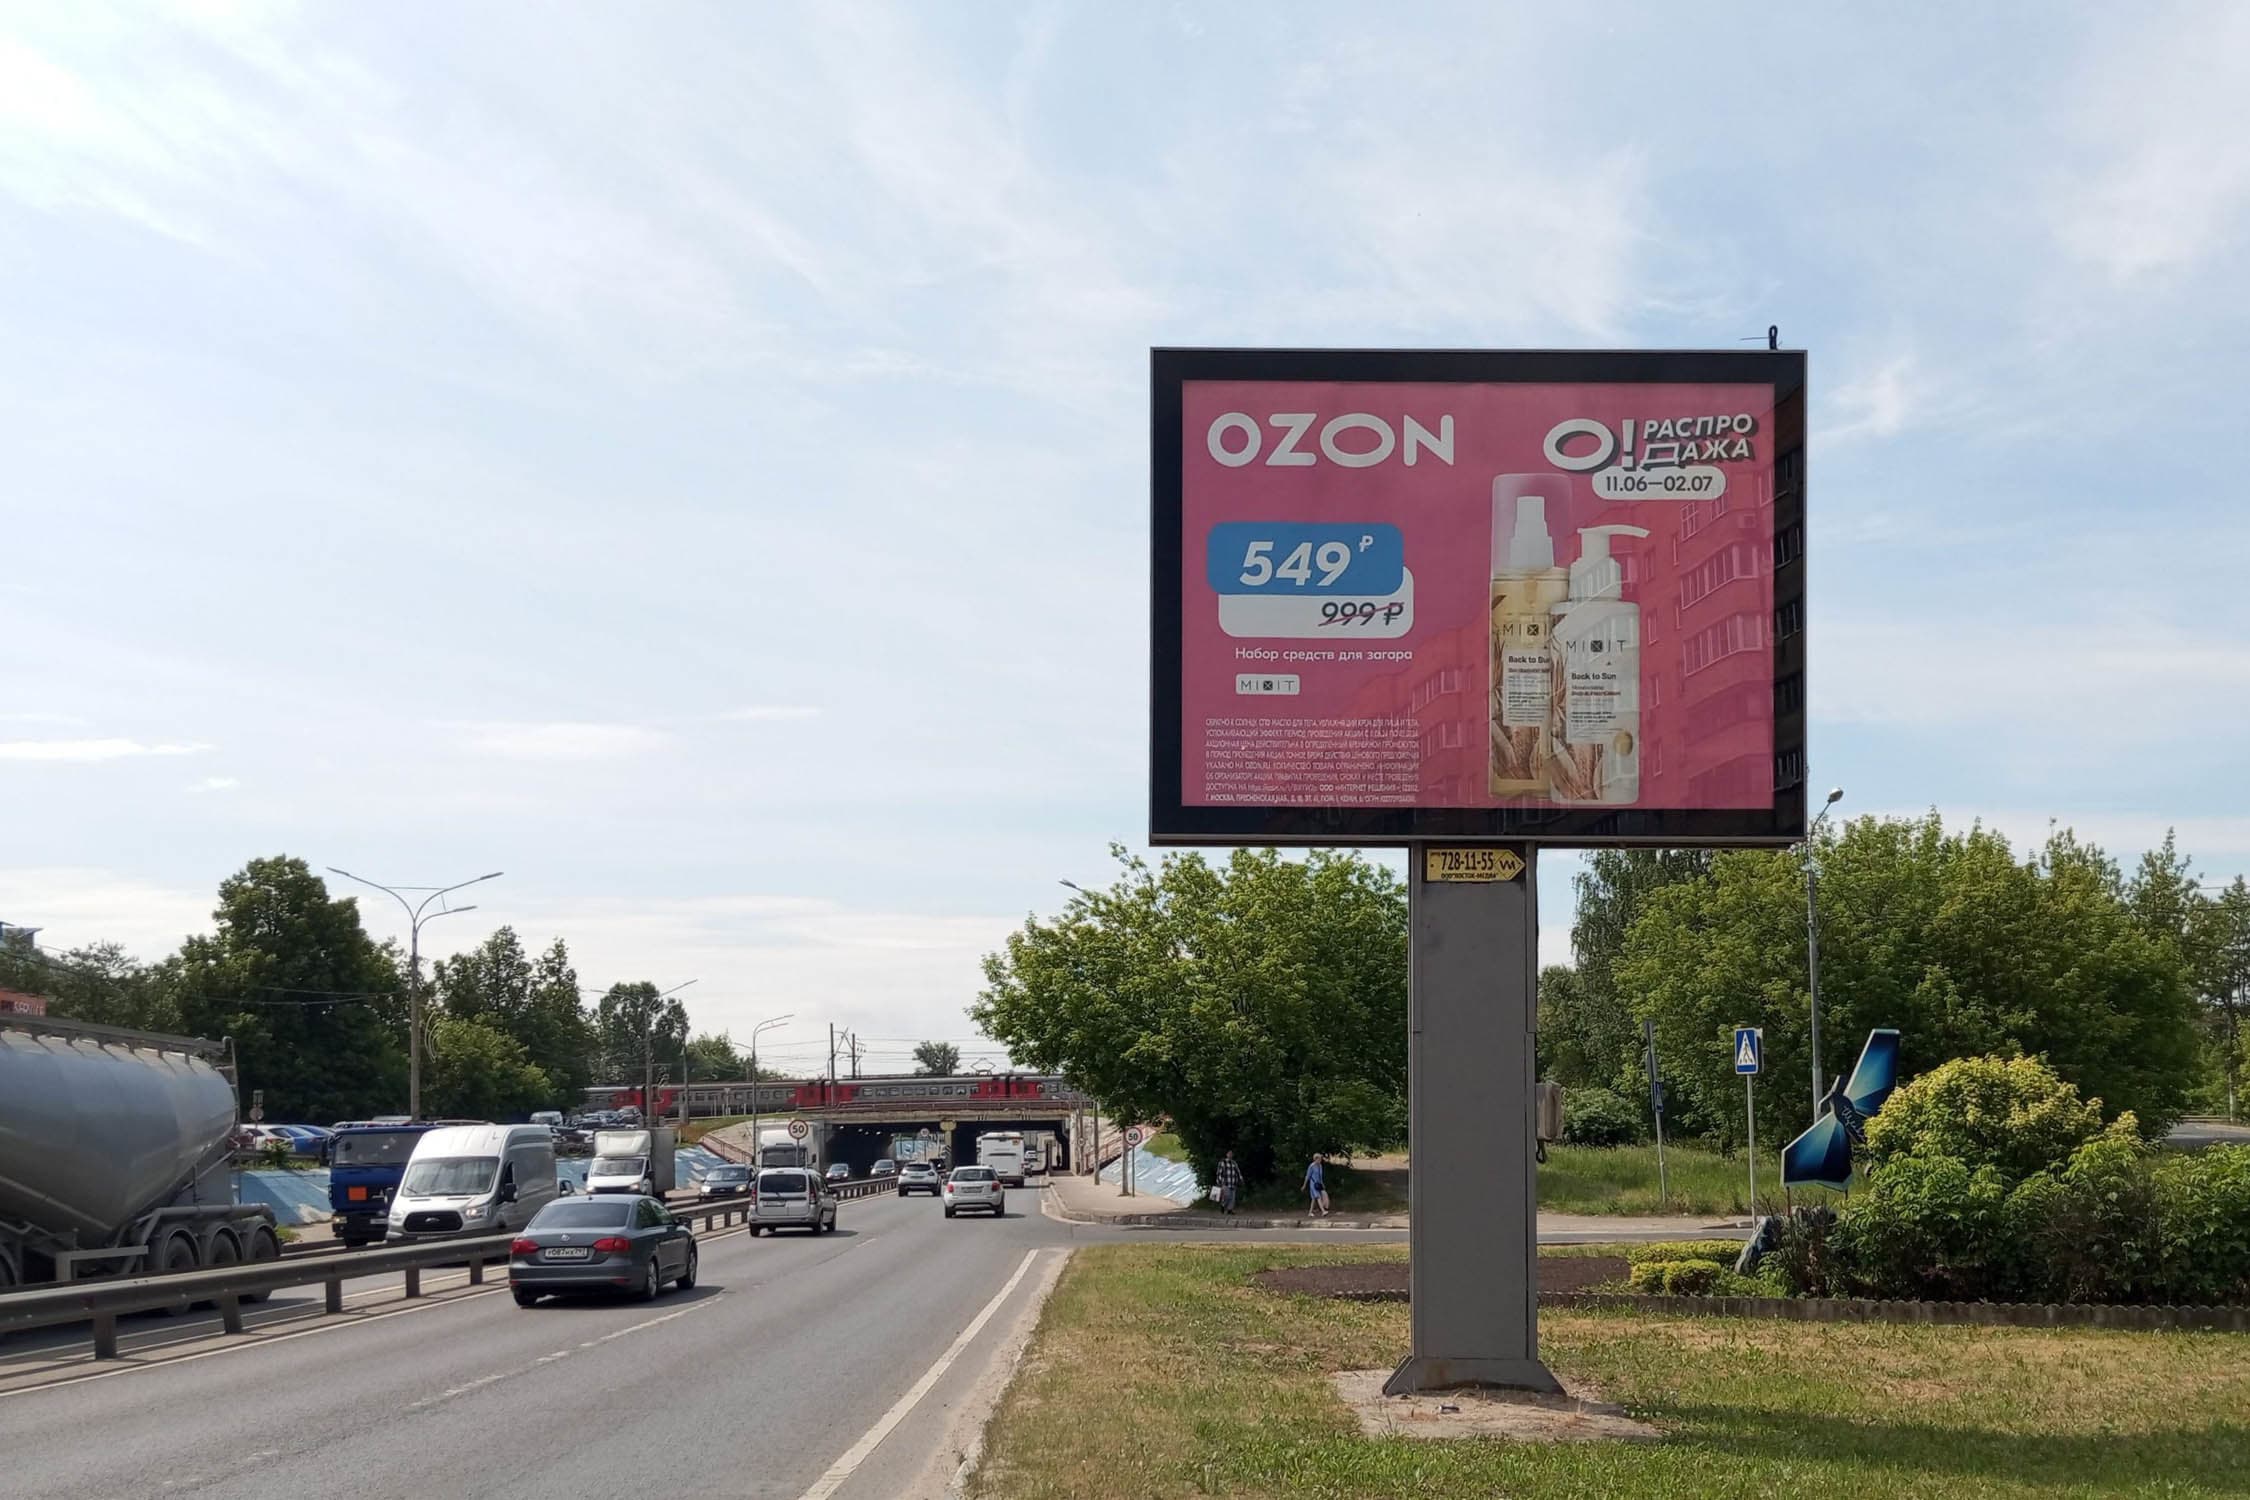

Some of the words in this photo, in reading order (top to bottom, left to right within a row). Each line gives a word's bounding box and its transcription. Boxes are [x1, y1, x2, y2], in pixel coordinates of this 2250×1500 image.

[1643, 413, 1754, 440] РАСПРО
[1207, 412, 1455, 468] OZON
[1639, 438, 1751, 467] ДАЖА
[1239, 541, 1351, 586] 549
[1235, 648, 1279, 662] Набор
[1283, 650, 1335, 662] средств
[1338, 650, 1363, 661] для
[1366, 650, 1413, 662] загара
[1508, 655, 1527, 664] Back
[1528, 656, 1536, 664] to
[1571, 672, 1591, 681] Back
[1592, 672, 1600, 681] to
[1601, 672, 1617, 681] Sun
[1441, 852, 1494, 870] 728-11-55
[792, 1125, 805, 1134] 50
[1128, 1132, 1139, 1141] 50
